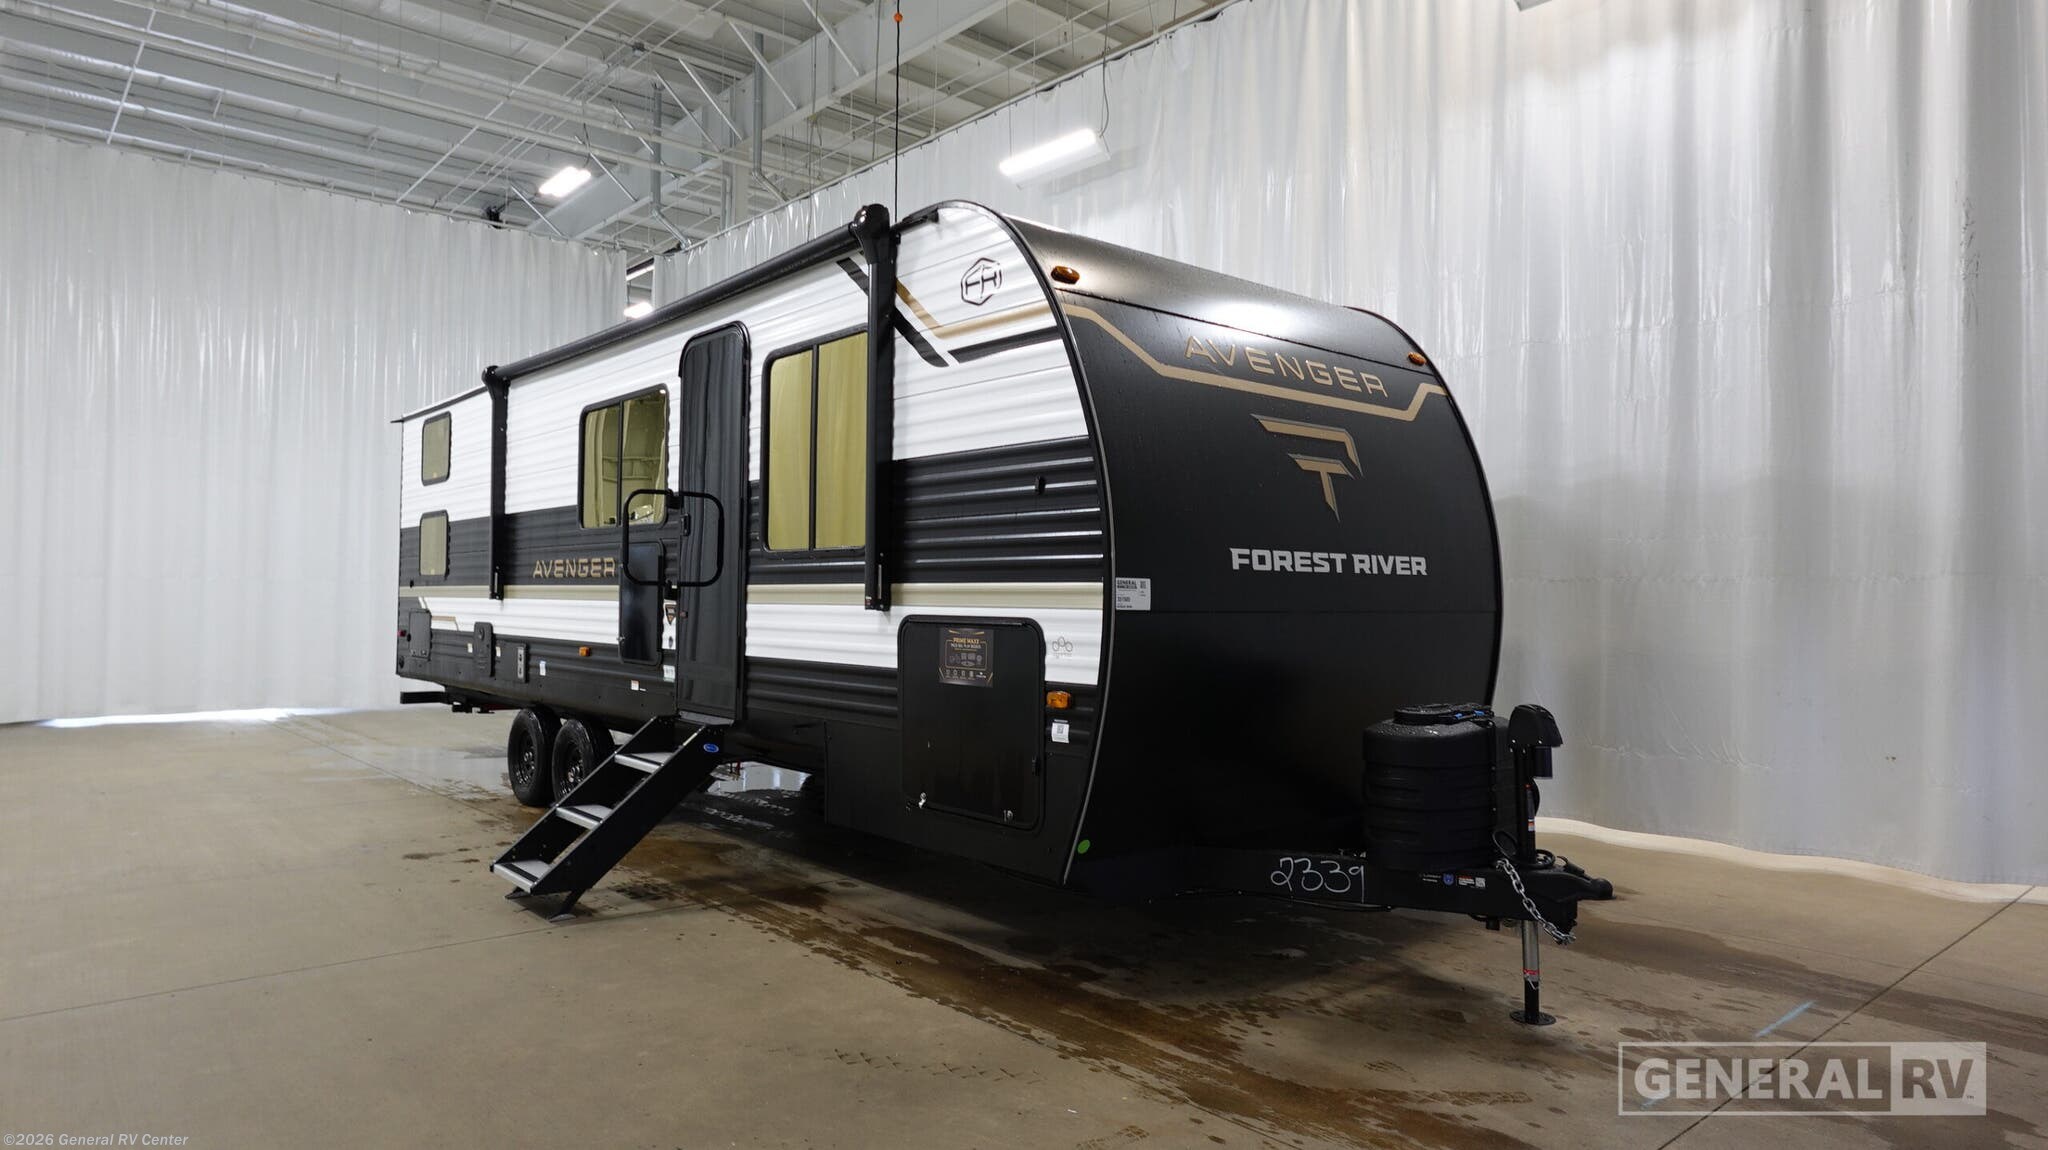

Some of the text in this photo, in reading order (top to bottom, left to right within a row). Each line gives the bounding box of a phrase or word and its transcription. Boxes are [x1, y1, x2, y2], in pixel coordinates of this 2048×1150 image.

[1184, 335, 1388, 398] AVENGER
[533, 557, 616, 579] AVENGER
[1230, 548, 1428, 576] FOREST RIVER
[1270, 857, 1364, 904] 2339
